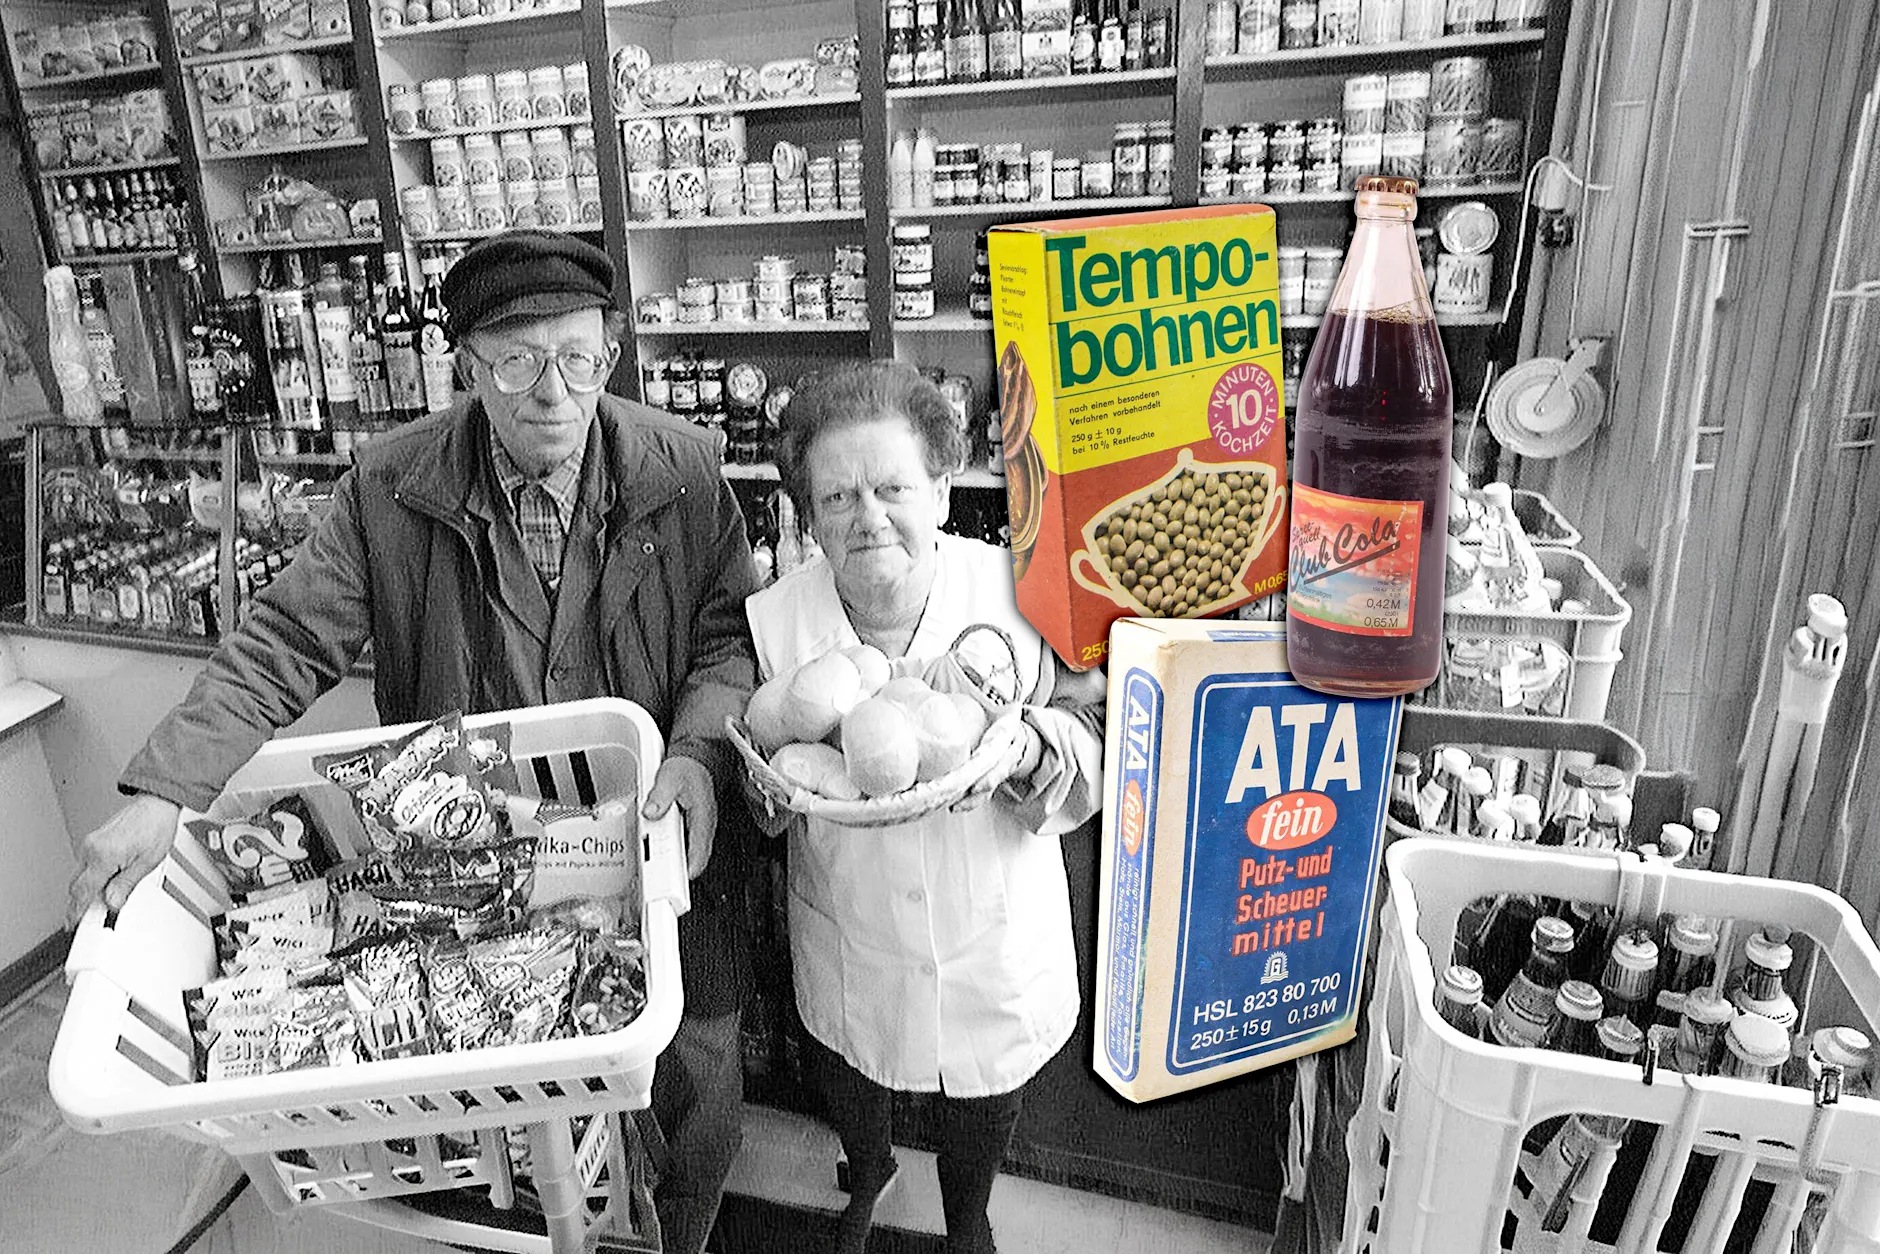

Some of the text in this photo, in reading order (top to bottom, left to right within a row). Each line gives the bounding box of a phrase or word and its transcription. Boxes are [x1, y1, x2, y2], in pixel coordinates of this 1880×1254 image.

[1045, 236, 1269, 313] Tempo-
[1056, 299, 1279, 389] bohnen
[1069, 390, 1160, 414] nach einem besonderen
[1212, 366, 1274, 409] MINUTEN
[1226, 389, 1262, 429] 10
[1069, 400, 1161, 426] Verfahren vorbehandelt
[1212, 405, 1276, 453] KOCHZEIT
[1072, 446, 1085, 455] bei
[1112, 431, 1155, 446] Restfeuchte
[1333, 516, 1400, 565] Cola
[1126, 695, 1150, 770] ATA
[1225, 703, 1362, 804] ATA
[1123, 789, 1140, 848] fein
[1259, 797, 1324, 846] fein
[1125, 862, 1133, 897] stände
[1132, 867, 1141, 901] reinigt
[1115, 915, 1123, 954] Marmor
[1130, 902, 1138, 937] schnell
[1230, 911, 1325, 957] mittel
[1111, 976, 1119, 1008] Metall
[1125, 958, 1134, 1003] gründlich
[1193, 972, 1341, 1026] HSL 823 80 700
